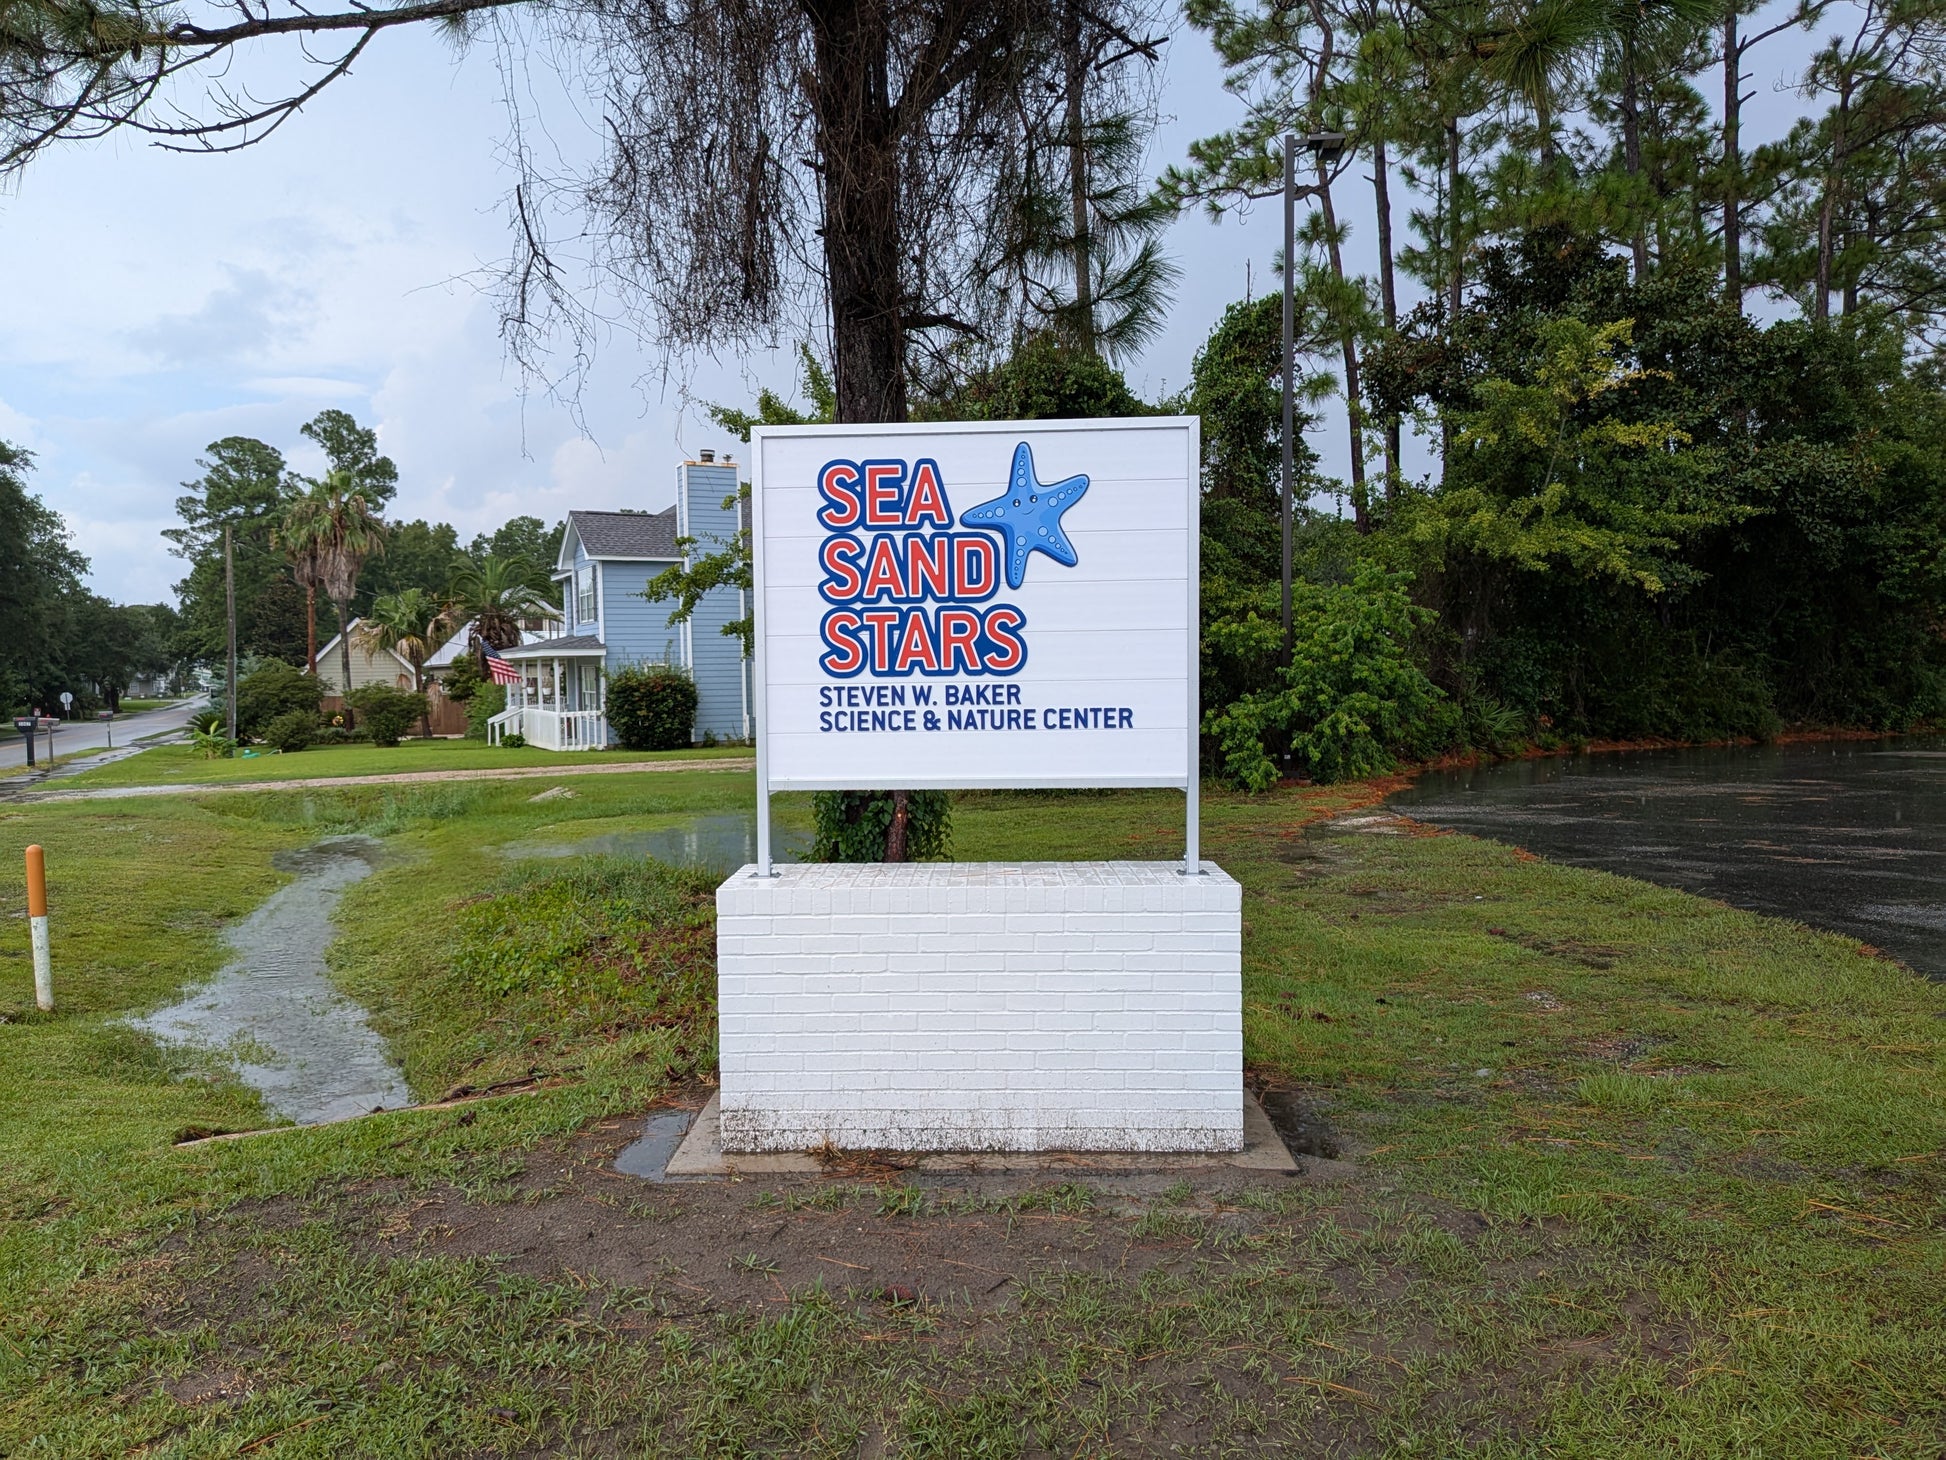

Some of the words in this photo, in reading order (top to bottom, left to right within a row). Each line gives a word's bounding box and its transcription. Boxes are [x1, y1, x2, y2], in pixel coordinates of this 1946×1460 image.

[820, 461, 951, 528] SEA
[821, 535, 998, 602] SAND
[821, 607, 1025, 675] STARS
[820, 685, 905, 707] STEVEN
[912, 685, 938, 706] W.
[945, 684, 1021, 706] BAKER
[820, 710, 917, 732] SCIENCE
[923, 710, 941, 731] &
[948, 709, 1037, 731] NATURE
[1043, 707, 1133, 729] CENTER
